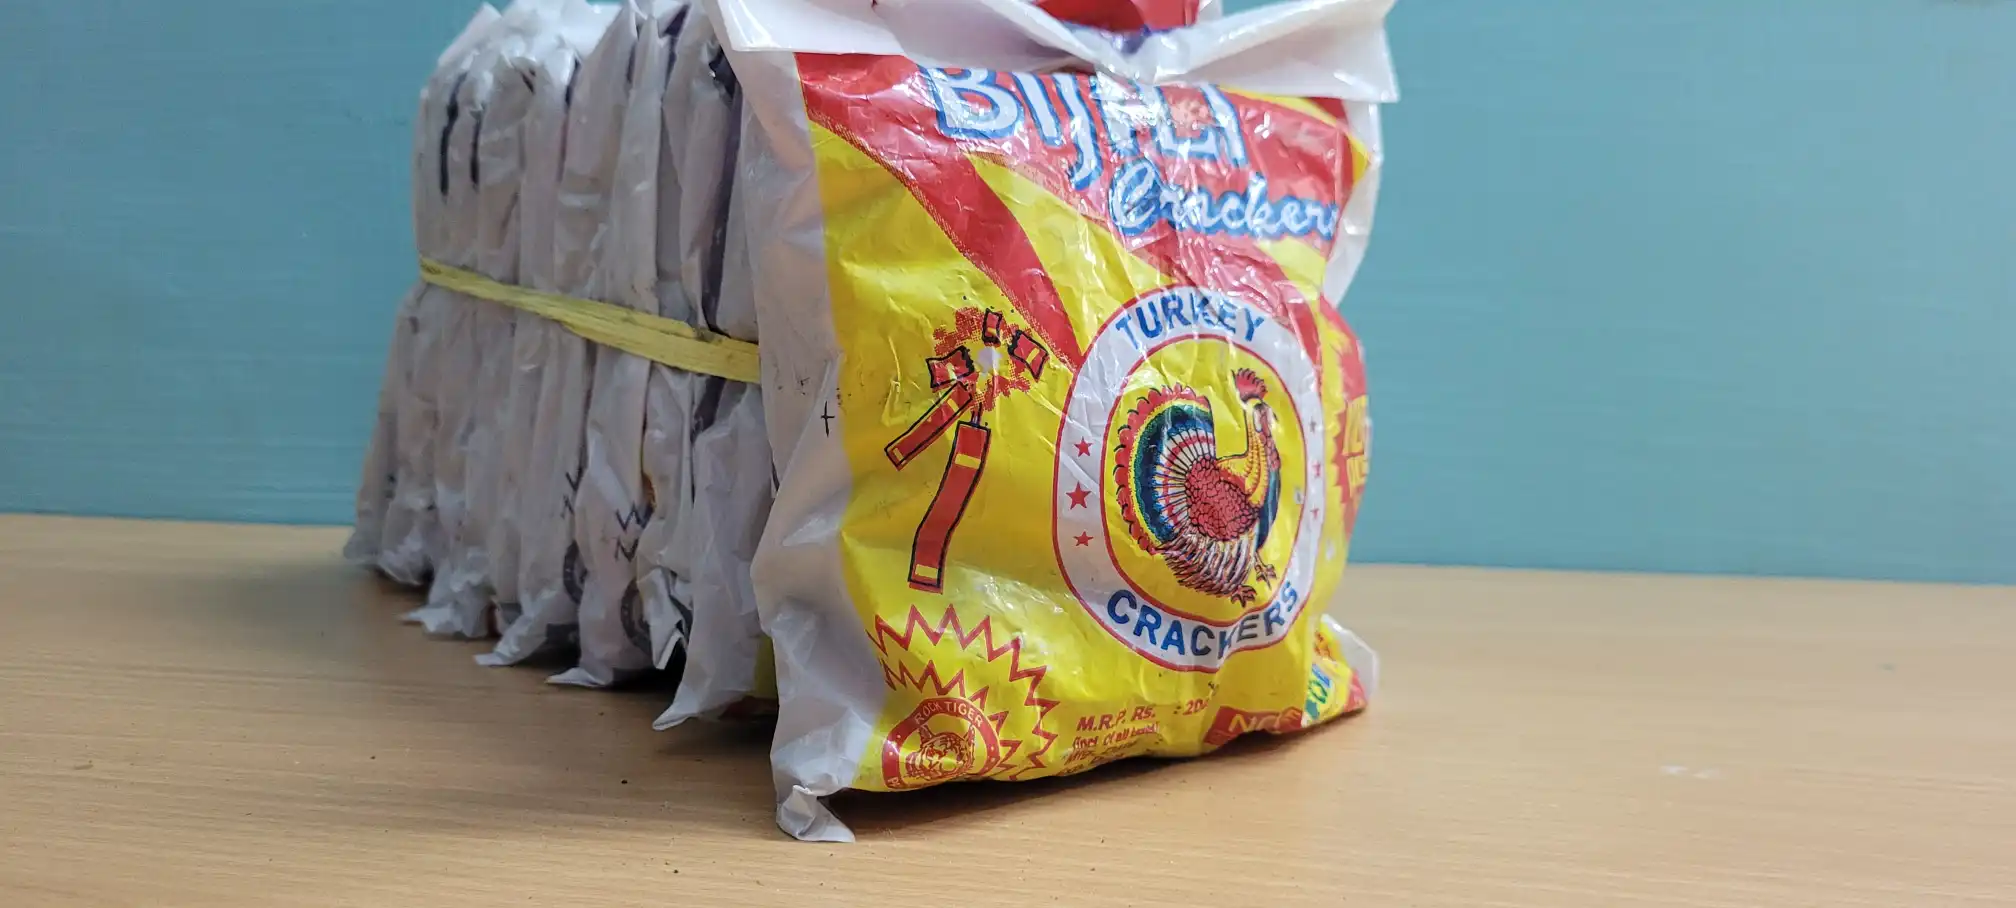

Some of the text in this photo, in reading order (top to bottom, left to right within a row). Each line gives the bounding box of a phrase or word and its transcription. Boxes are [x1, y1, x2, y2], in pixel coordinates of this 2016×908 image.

[1115, 292, 1265, 351] TURKEY
[1106, 580, 1299, 659] CRACKERS
[914, 700, 984, 728] ROCK TIGER
